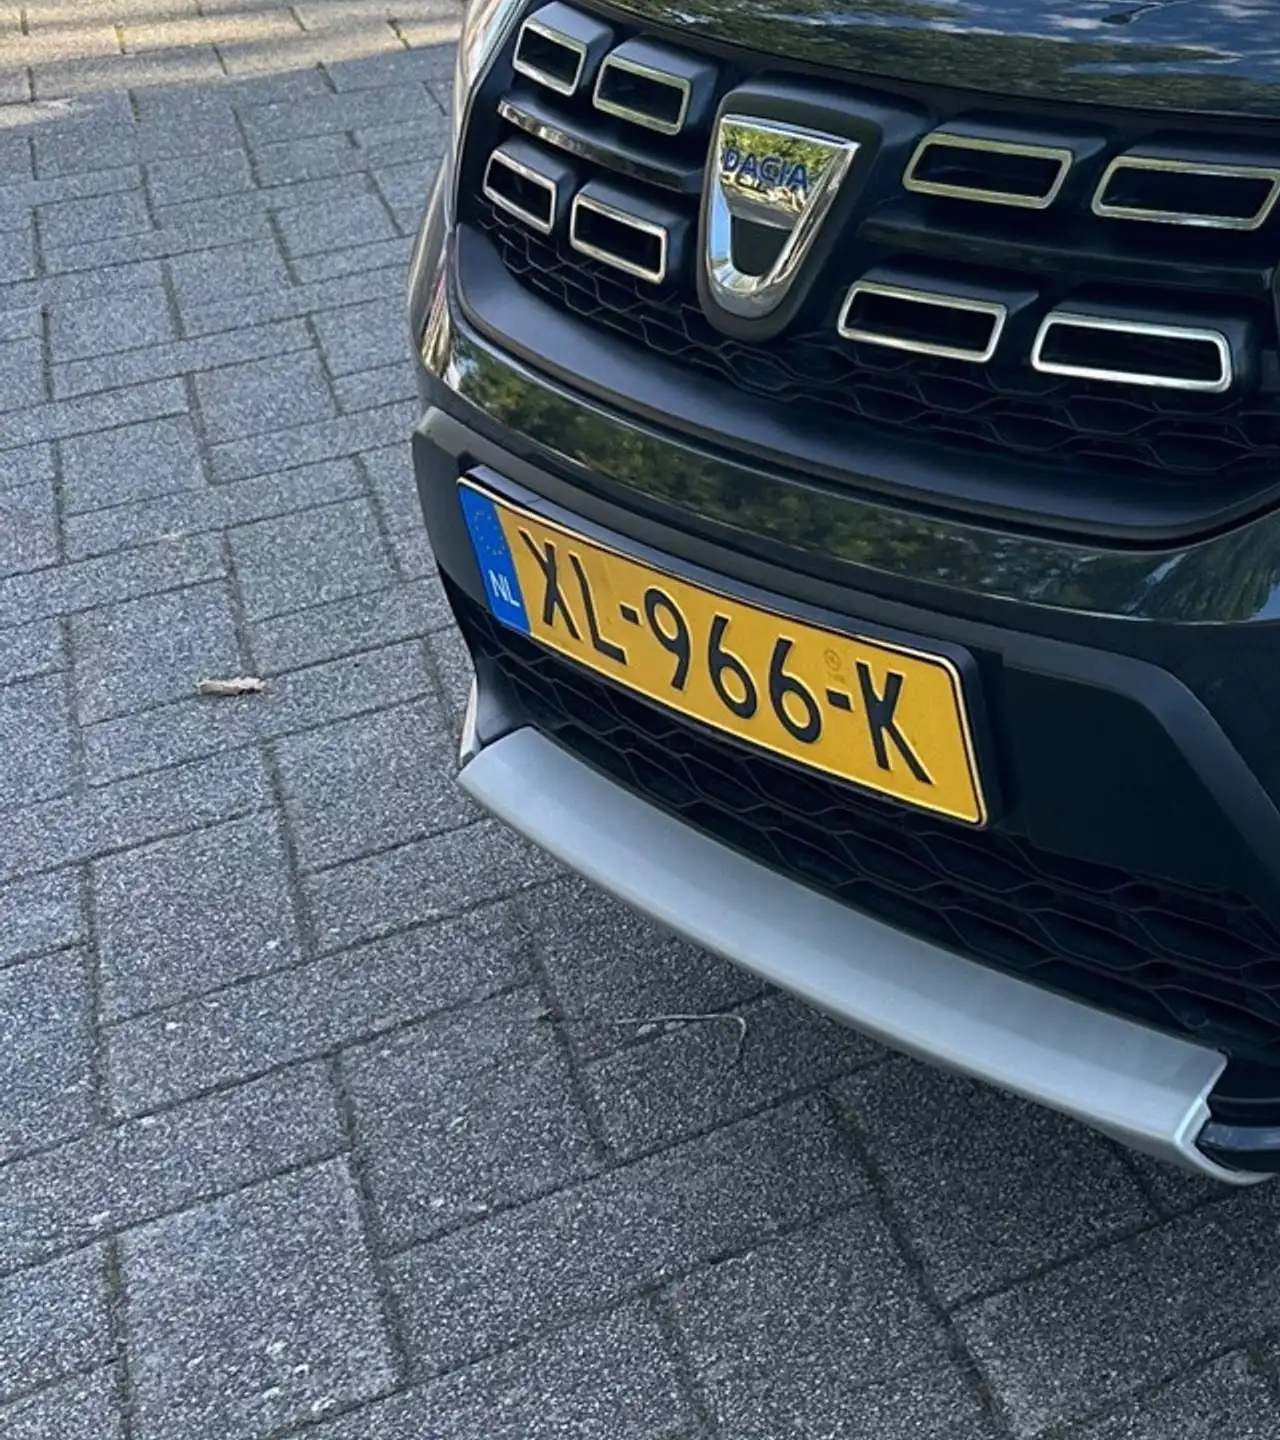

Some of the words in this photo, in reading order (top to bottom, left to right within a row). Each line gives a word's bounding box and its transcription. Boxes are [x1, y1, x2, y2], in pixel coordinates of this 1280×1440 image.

[722, 146, 809, 191] DACIA
[488, 569, 521, 608] NL
[518, 526, 935, 786] XL-966-K
